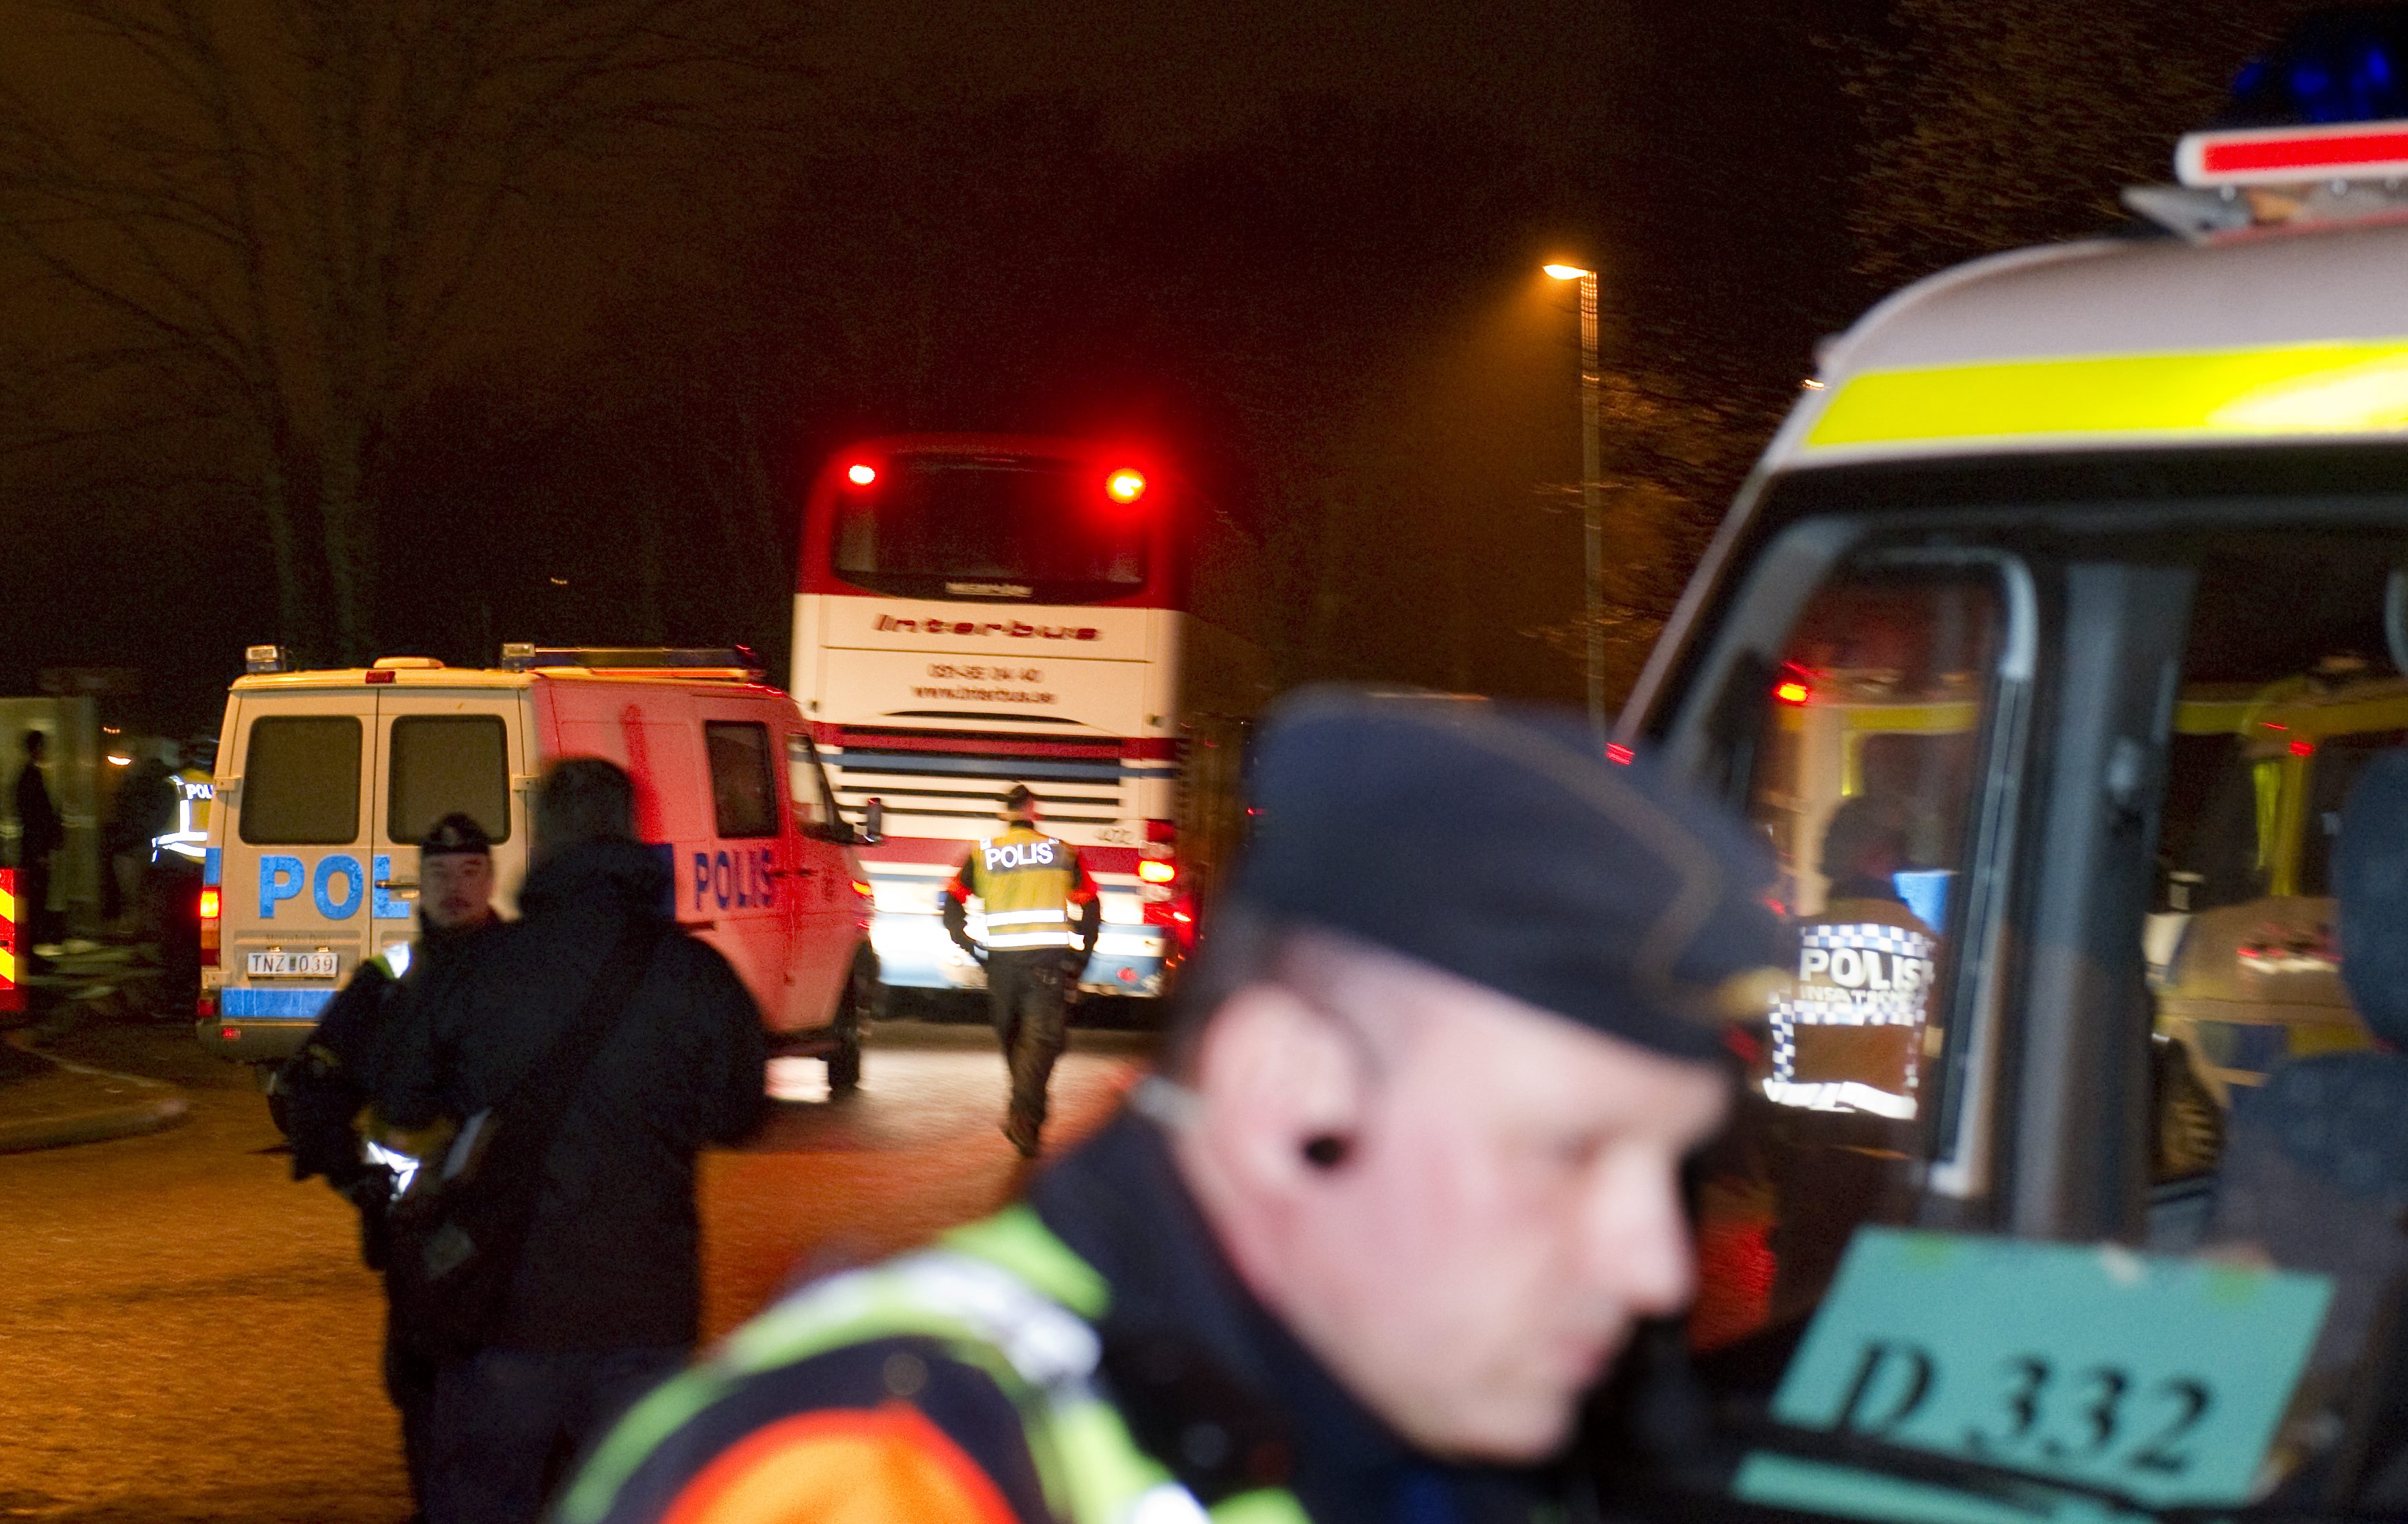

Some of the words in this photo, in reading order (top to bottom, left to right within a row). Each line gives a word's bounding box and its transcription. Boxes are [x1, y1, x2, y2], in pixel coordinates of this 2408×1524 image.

[872, 614, 1103, 641] Interbus
[185, 783, 214, 799] POL
[985, 842, 1054, 870] POLIS
[258, 854, 410, 919] POL
[693, 849, 772, 911] POLIS
[253, 955, 286, 972] TNZ
[299, 955, 333, 972] 039
[1800, 947, 1923, 991] POLIS
[1834, 1340, 1937, 1438] D
[1963, 1352, 2214, 1476] 332
